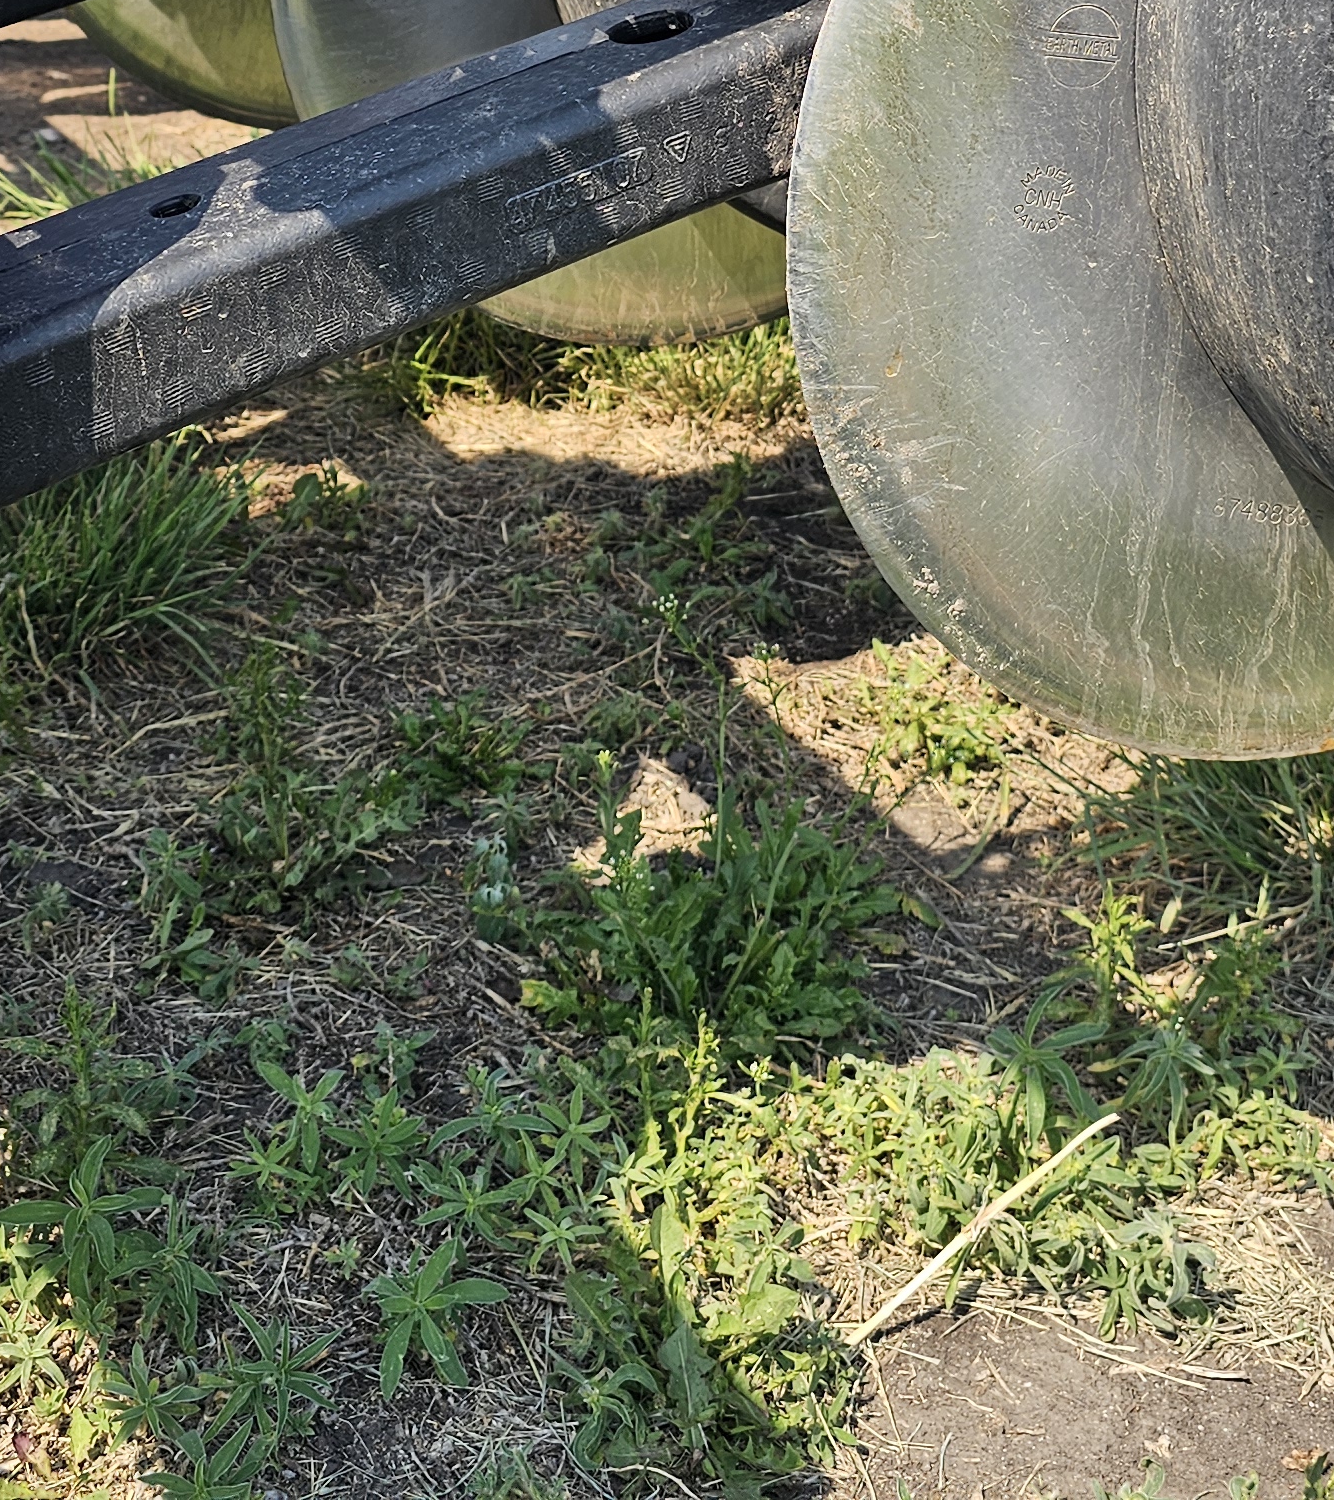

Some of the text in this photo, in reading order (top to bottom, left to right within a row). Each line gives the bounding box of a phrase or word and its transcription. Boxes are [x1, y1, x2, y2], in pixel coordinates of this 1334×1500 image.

[1044, 36, 1118, 58] EARTH METAL
[1020, 165, 1075, 197] MADE IN
[1024, 188, 1064, 211] CNH
[1013, 204, 1075, 233] CANADA
